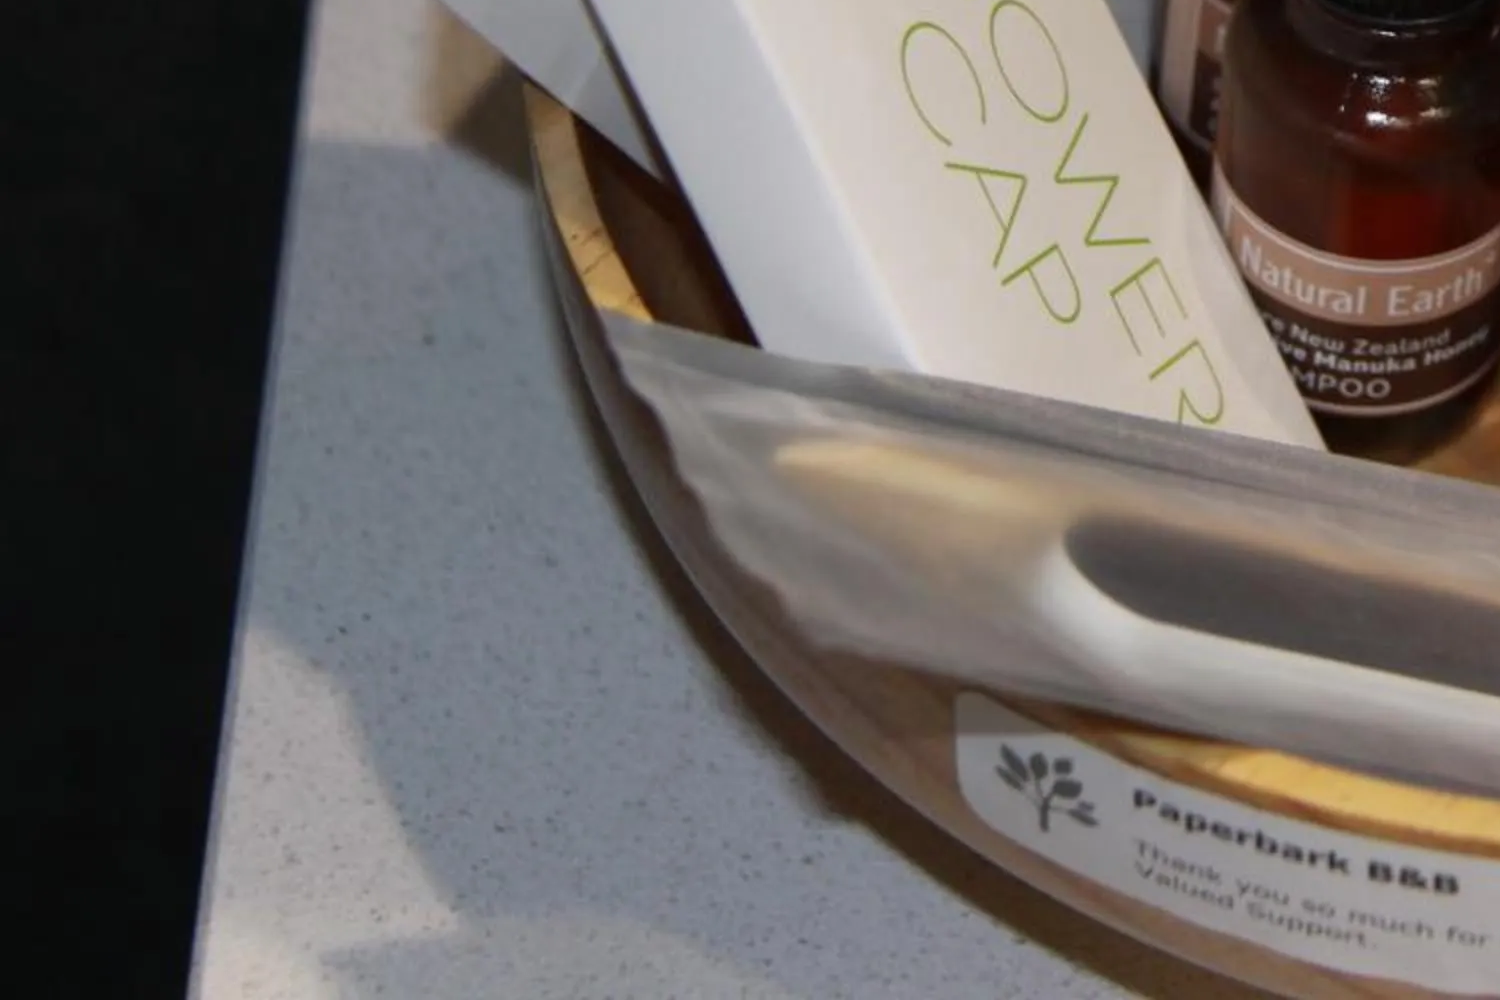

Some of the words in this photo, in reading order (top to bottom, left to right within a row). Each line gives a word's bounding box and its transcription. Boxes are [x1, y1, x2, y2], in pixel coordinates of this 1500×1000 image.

[900, 21, 1082, 325] CAP
[1240, 235, 1367, 316] Natural
[1289, 322, 1346, 354] New
[1351, 327, 1451, 357] Zealand
[1313, 350, 1417, 373] Manuka
[1291, 365, 1392, 399] MPOO
[1132, 786, 1353, 875] Paperbark
[1366, 857, 1461, 897] B&B
[1132, 836, 1223, 884] Thank
[1235, 878, 1291, 907] you
[1299, 899, 1337, 920] so
[1348, 908, 1436, 940] much
[1446, 925, 1491, 948] for
[1133, 860, 1236, 912] Valued
